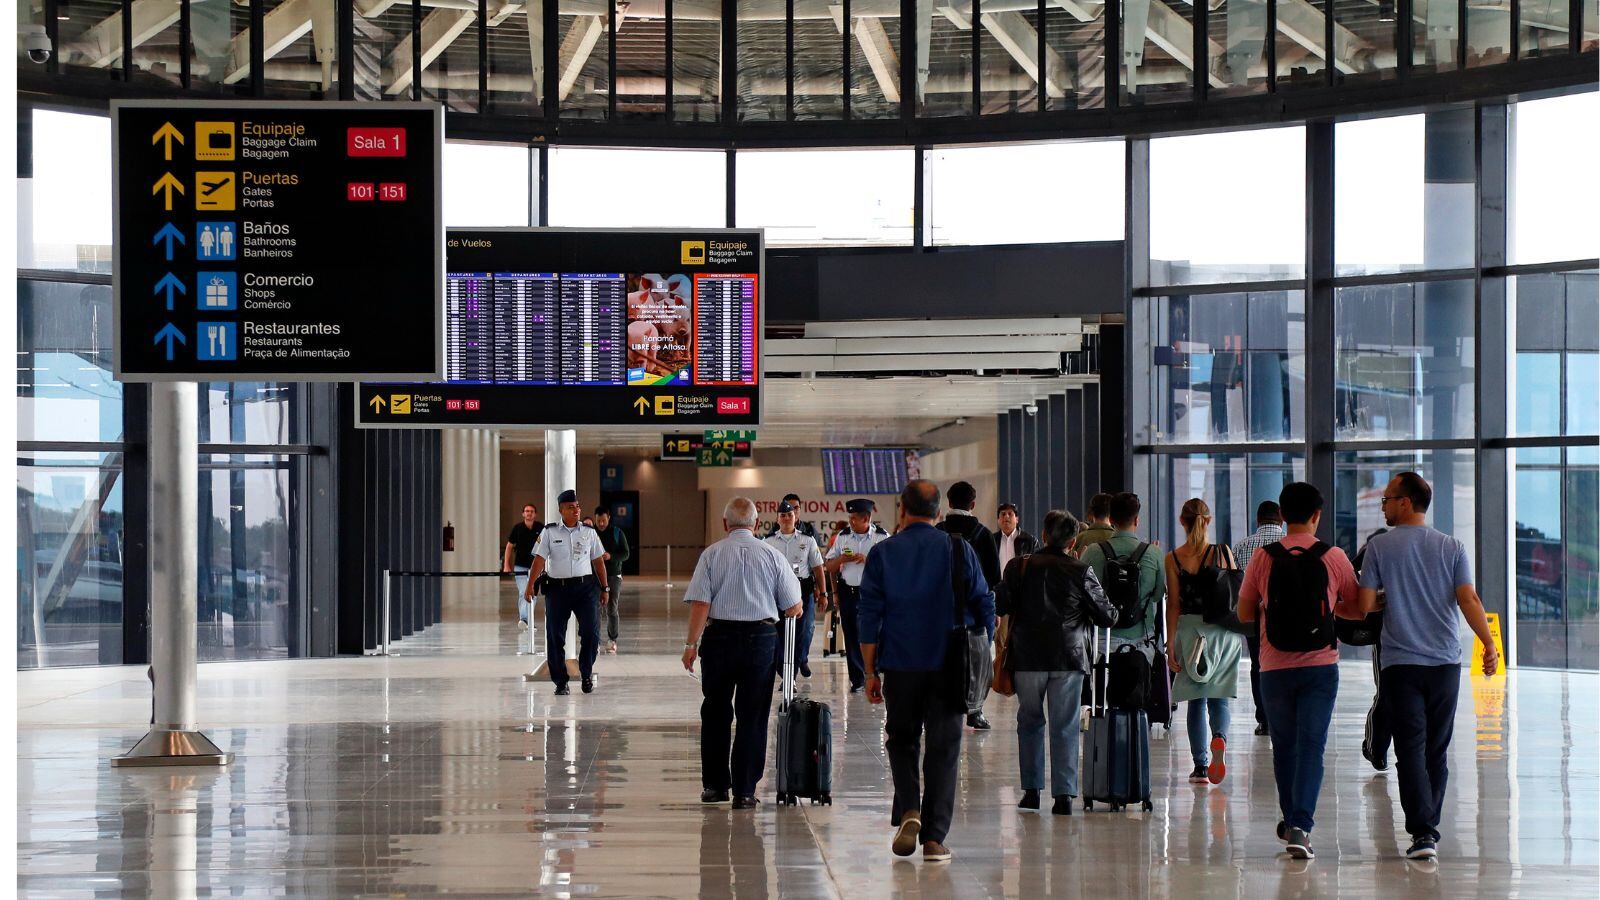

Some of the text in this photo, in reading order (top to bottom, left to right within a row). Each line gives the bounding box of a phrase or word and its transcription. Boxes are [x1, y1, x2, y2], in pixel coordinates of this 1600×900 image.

[243, 122, 305, 136] Equipaje
[243, 137, 317, 148] Baggage Claim
[354, 135, 400, 150] Sala 1
[243, 149, 289, 159] Bagagem
[243, 172, 299, 185] Puertas
[243, 187, 272, 197] Gates
[243, 199, 275, 208] Portas
[243, 221, 290, 235] Baños
[244, 237, 297, 246] Bathrooms
[447, 239, 492, 249] de Vuelos
[709, 240, 748, 251] Equipaje
[244, 248, 293, 258] Banheiros
[709, 249, 753, 258] Baggage Claim
[244, 273, 314, 287] Comercio
[244, 288, 276, 300] Shops
[244, 300, 291, 310] Comércio
[244, 322, 341, 335] Restaurantes
[244, 337, 303, 346] Restaurants
[632, 343, 650, 351] LIBRE
[651, 343, 660, 351] de
[244, 348, 351, 359] Praça de Alimentação
[678, 396, 709, 404] Equipaje
[742, 401, 747, 409] 1
